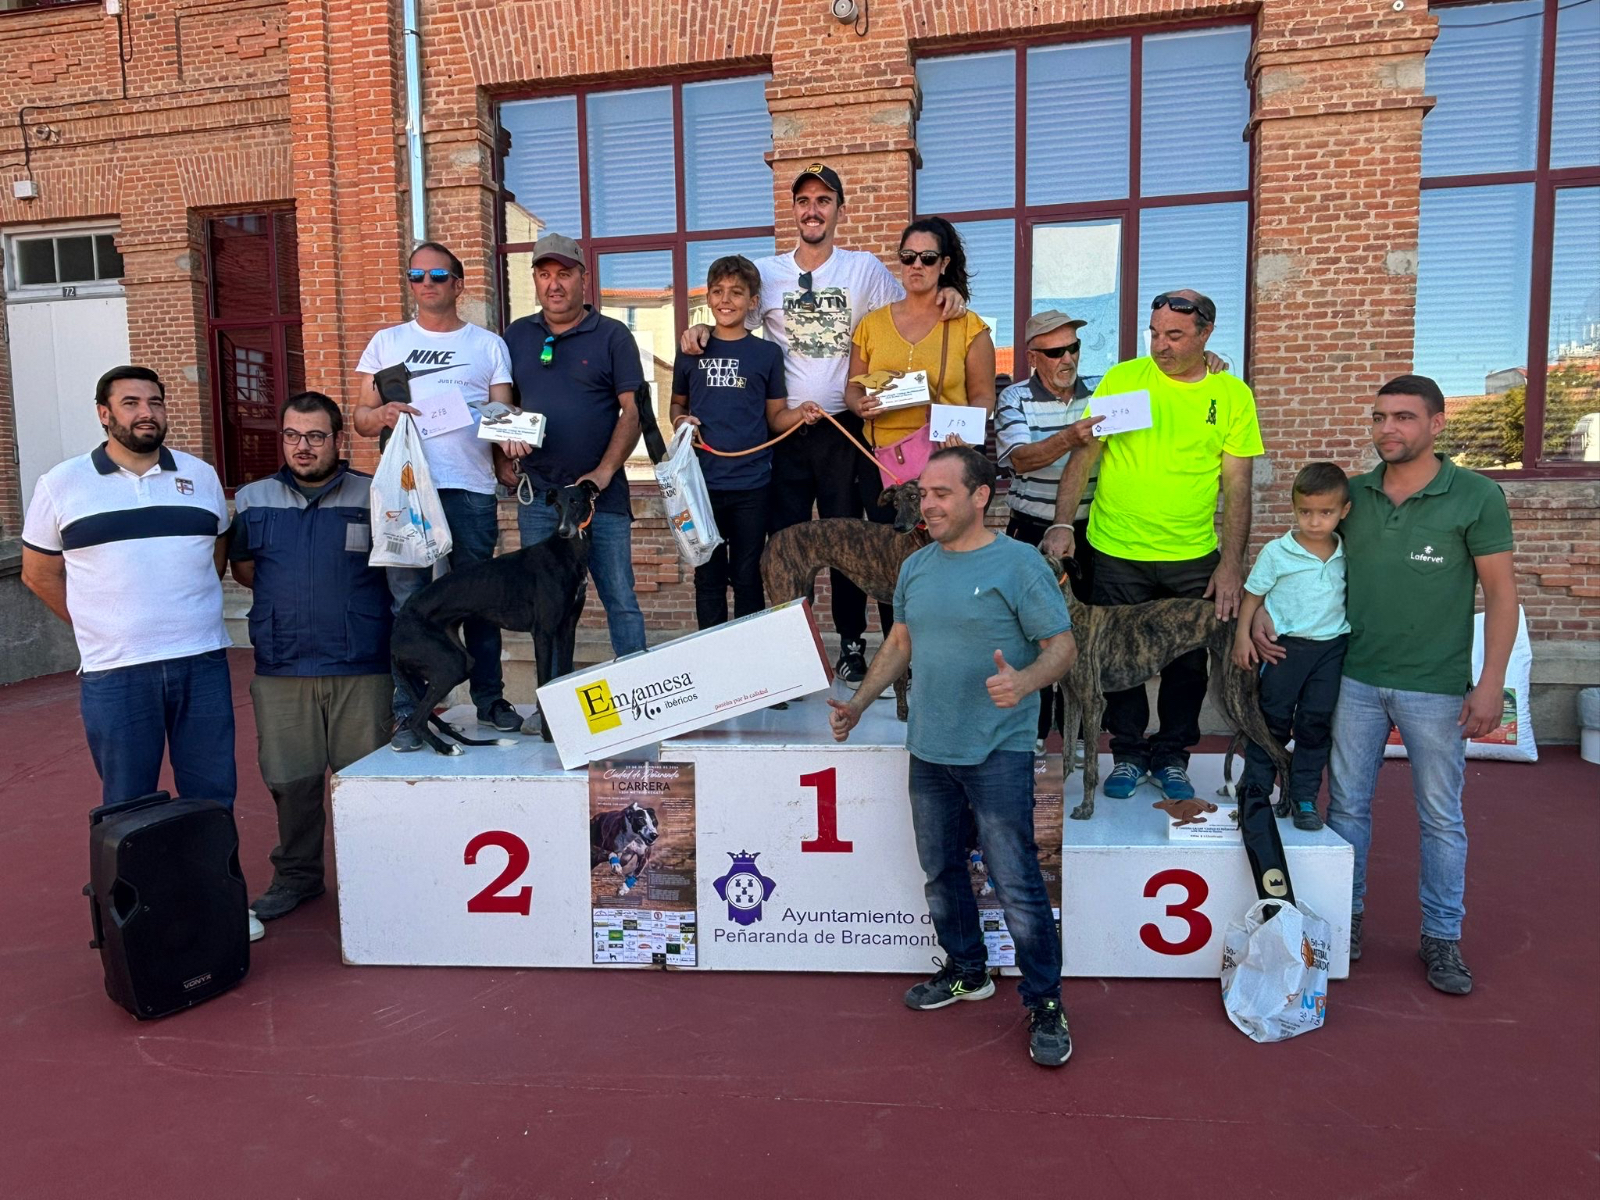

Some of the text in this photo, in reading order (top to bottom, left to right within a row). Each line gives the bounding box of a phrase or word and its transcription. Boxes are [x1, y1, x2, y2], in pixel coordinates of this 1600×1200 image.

[64, 287, 75, 298] 72
[405, 349, 456, 365] NIKE
[699, 358, 740, 369] VALE
[707, 367, 737, 377] CUA
[707, 376, 737, 386] TRO
[1410, 551, 1444, 563] Lafervet
[664, 692, 699, 710] ibéricos
[603, 769, 633, 780] Ciudad
[632, 770, 641, 780] de
[612, 781, 671, 791] I CARRERA
[800, 768, 852, 852] 1
[465, 831, 531, 915] 2
[782, 908, 932, 925] Ayuntamiento d
[1141, 870, 1211, 954] 3
[714, 928, 940, 947] Peñaranda de Bracamont
[183, 973, 212, 989] VONYX
